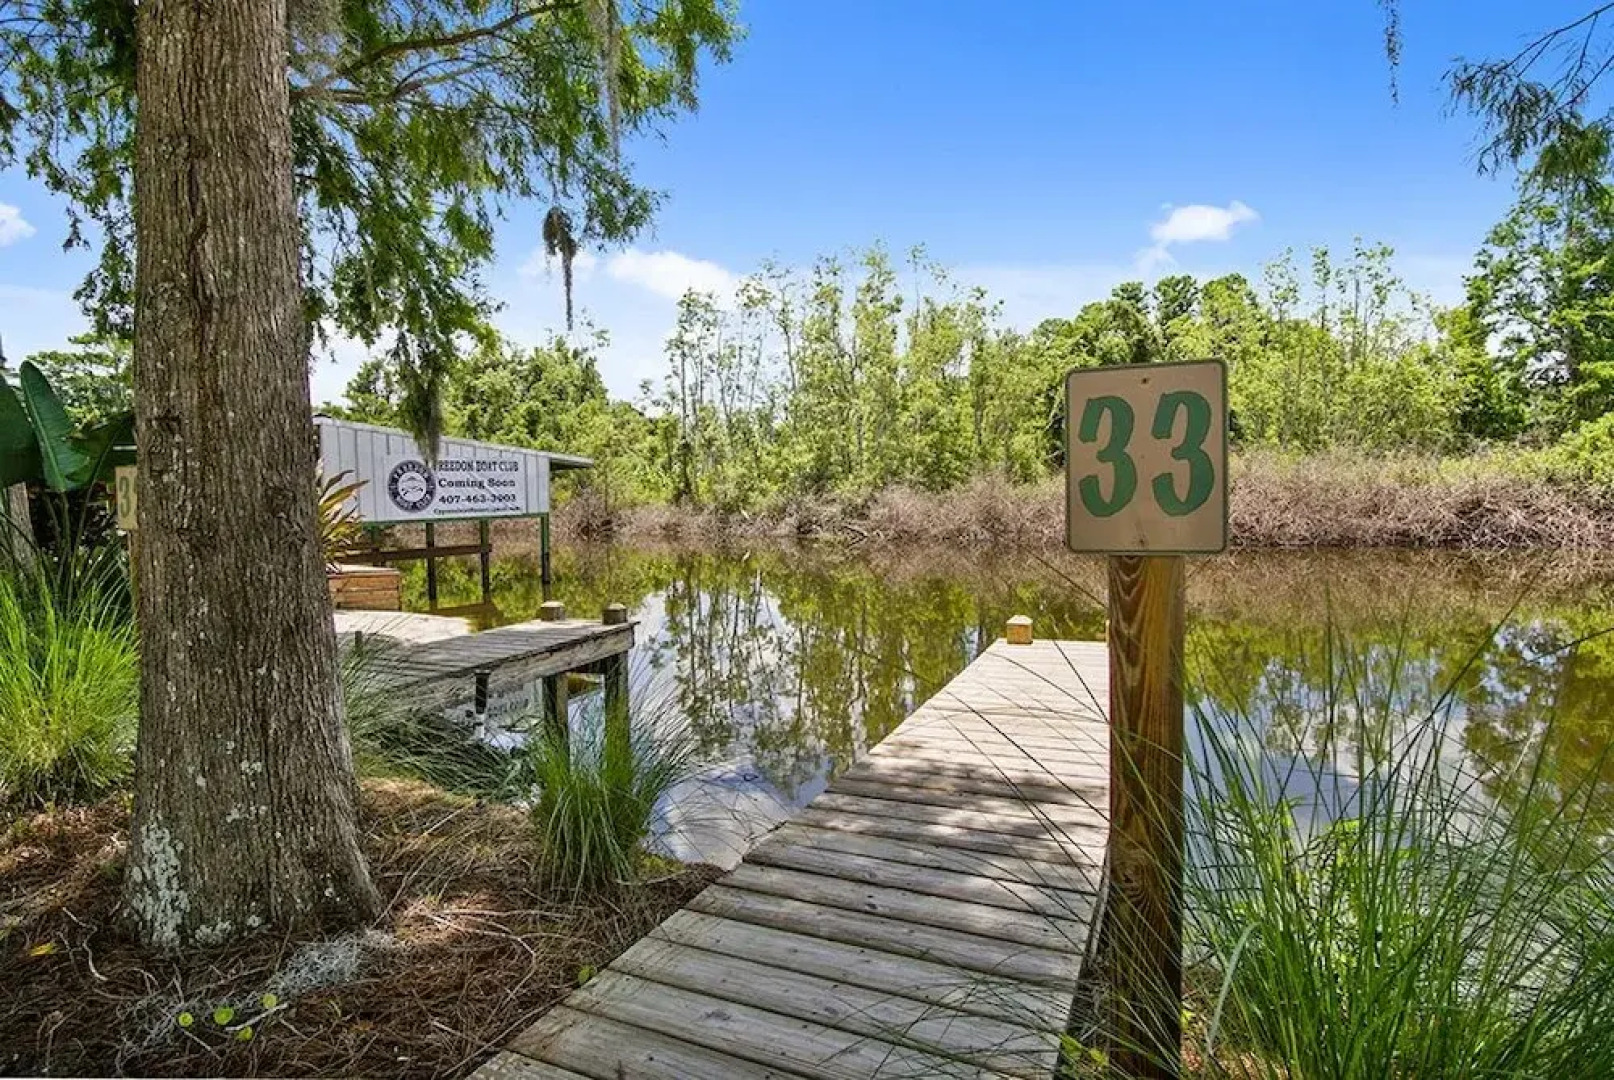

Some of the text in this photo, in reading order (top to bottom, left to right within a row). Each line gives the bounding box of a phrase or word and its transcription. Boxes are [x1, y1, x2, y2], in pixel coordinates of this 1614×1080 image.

[1078, 391, 1215, 518] 33
[476, 460, 497, 472] BOAT
[499, 460, 519, 472] CLUB
[439, 478, 516, 490] Coming Soon
